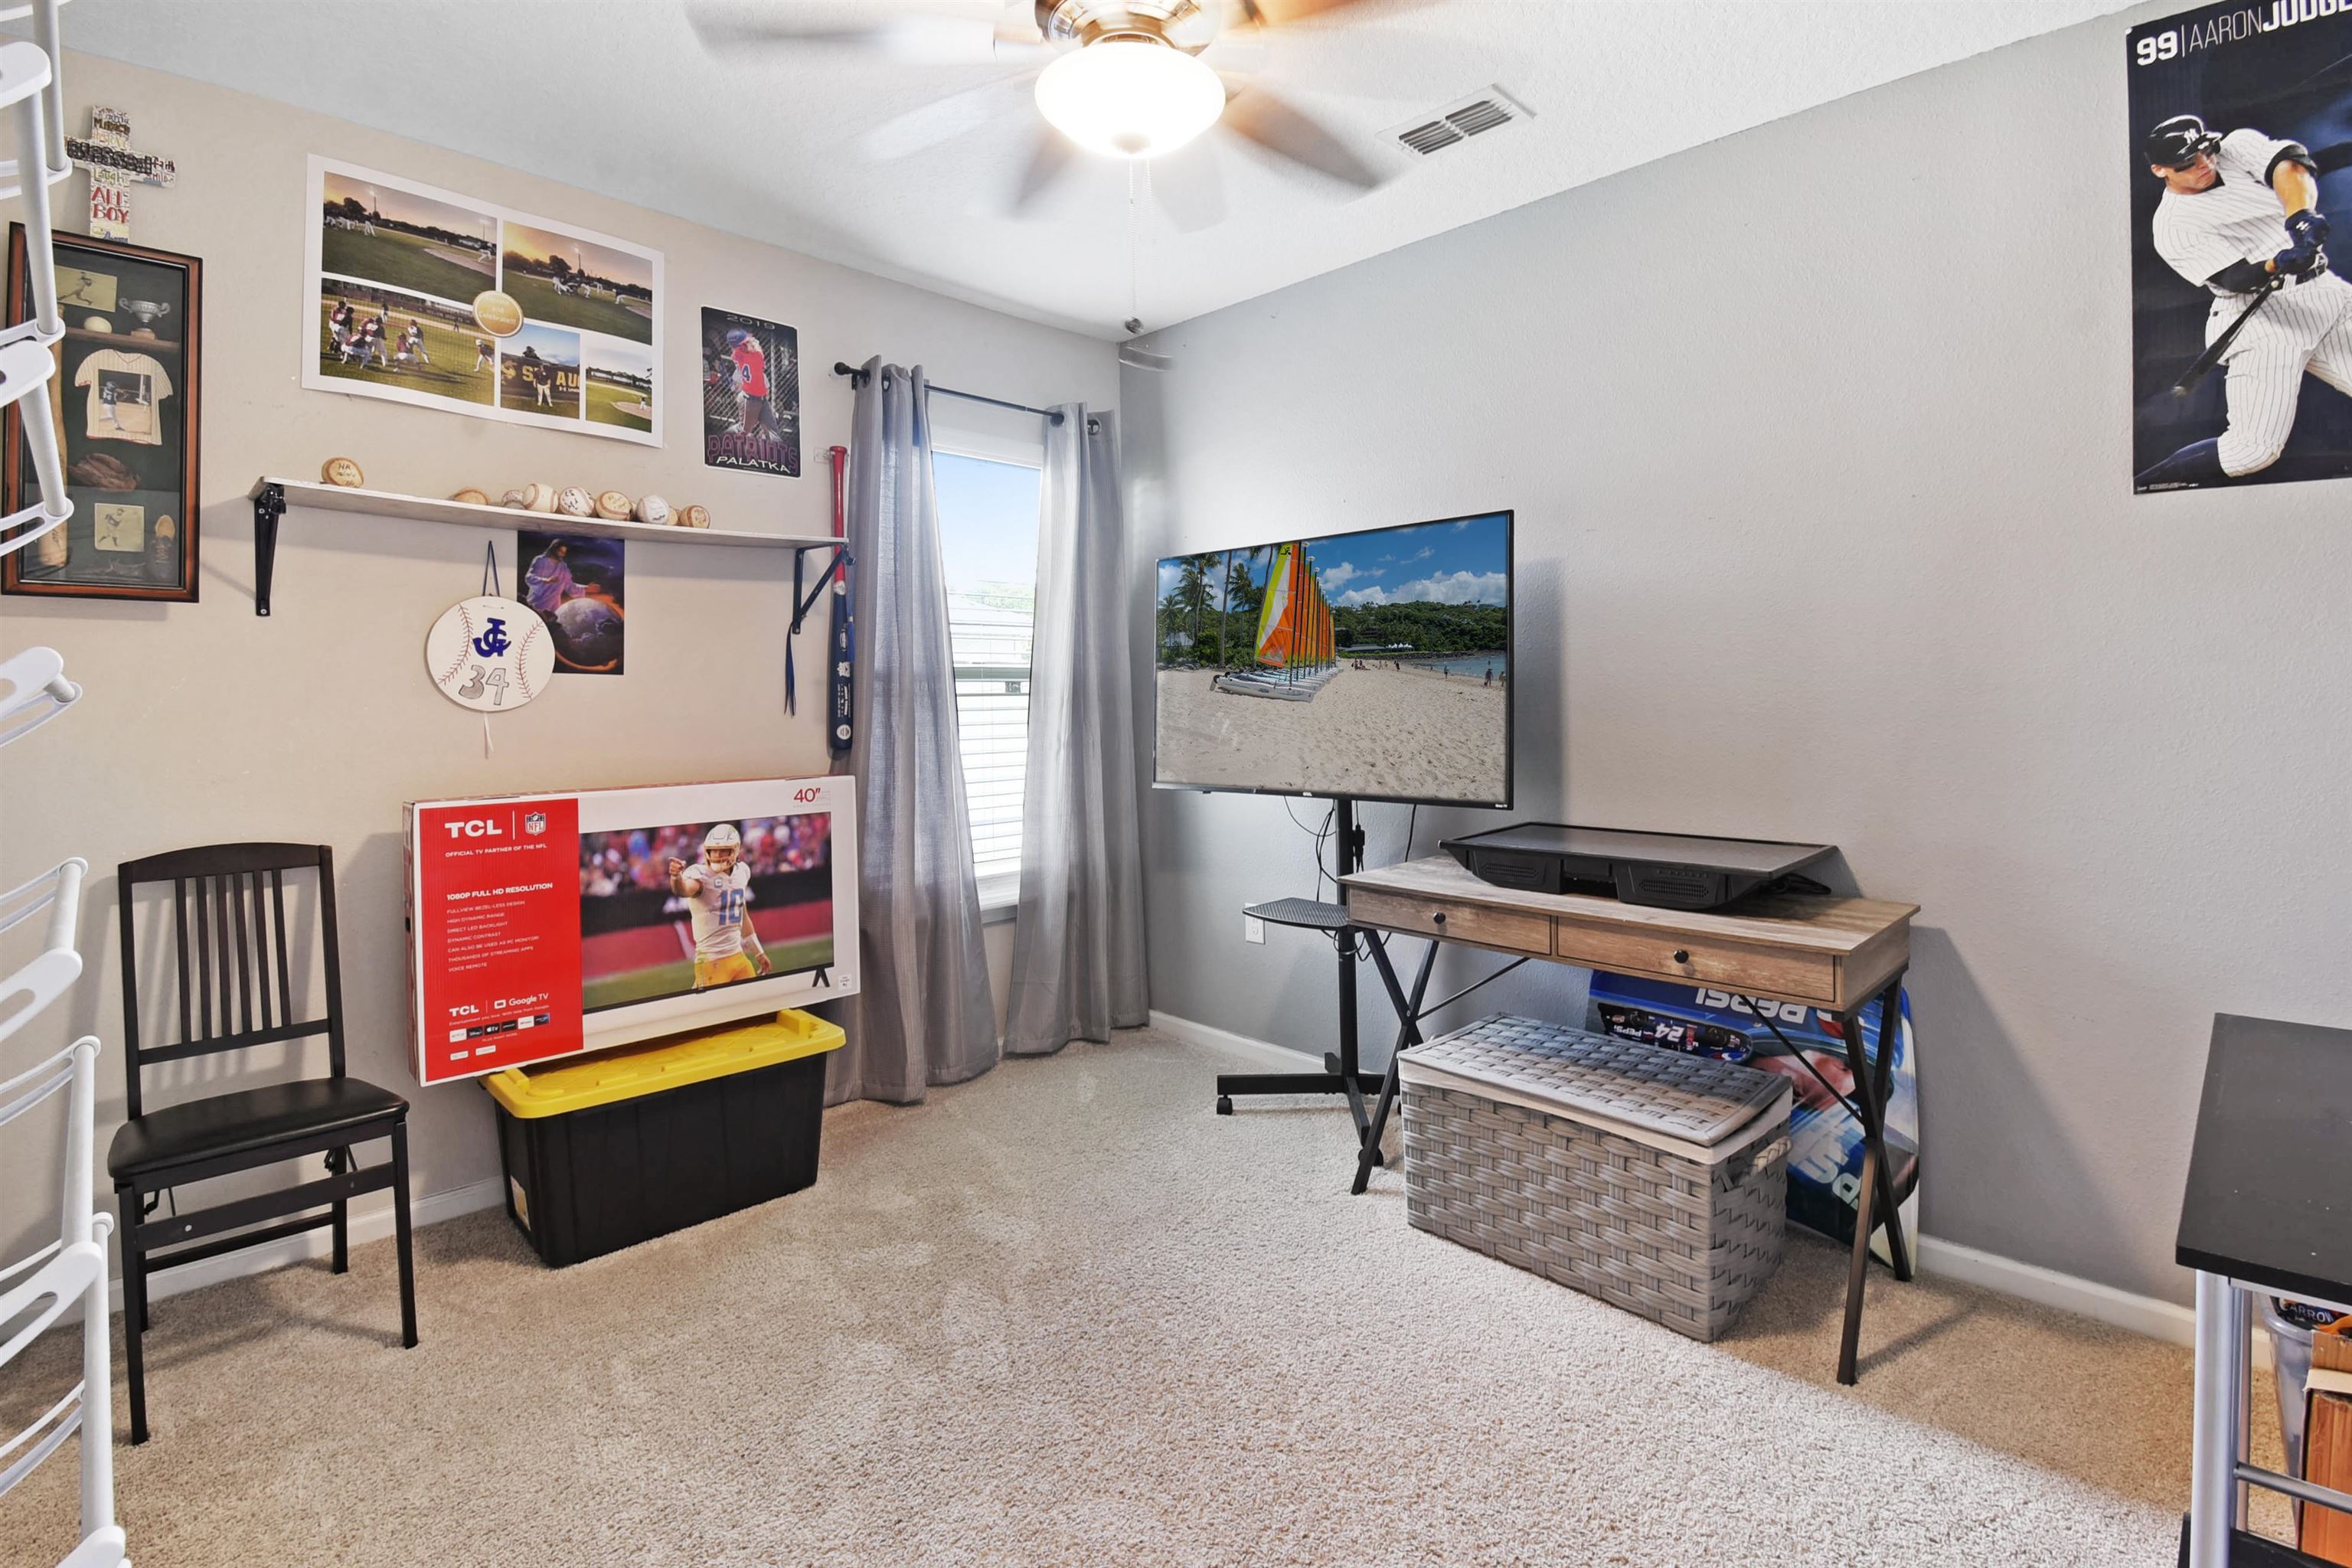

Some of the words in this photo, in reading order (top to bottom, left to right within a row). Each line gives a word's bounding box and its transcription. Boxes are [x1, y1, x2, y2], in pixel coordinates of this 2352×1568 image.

[2136, 31, 2177, 67] 99
[2189, 6, 2262, 53] AARON
[93, 204, 129, 224] BOY
[707, 433, 799, 475] PATRIOTS
[716, 456, 791, 474] PALATKA
[459, 664, 509, 705] 34
[445, 819, 502, 838] TCL
[446, 892, 471, 901] 1080P
[505, 882, 553, 893] RESOLUTION
[449, 1004, 479, 1018] TCL
[508, 995, 537, 1006] Google
[1695, 988, 1808, 1024] PEPSI
[1655, 1022, 1684, 1043] 24
